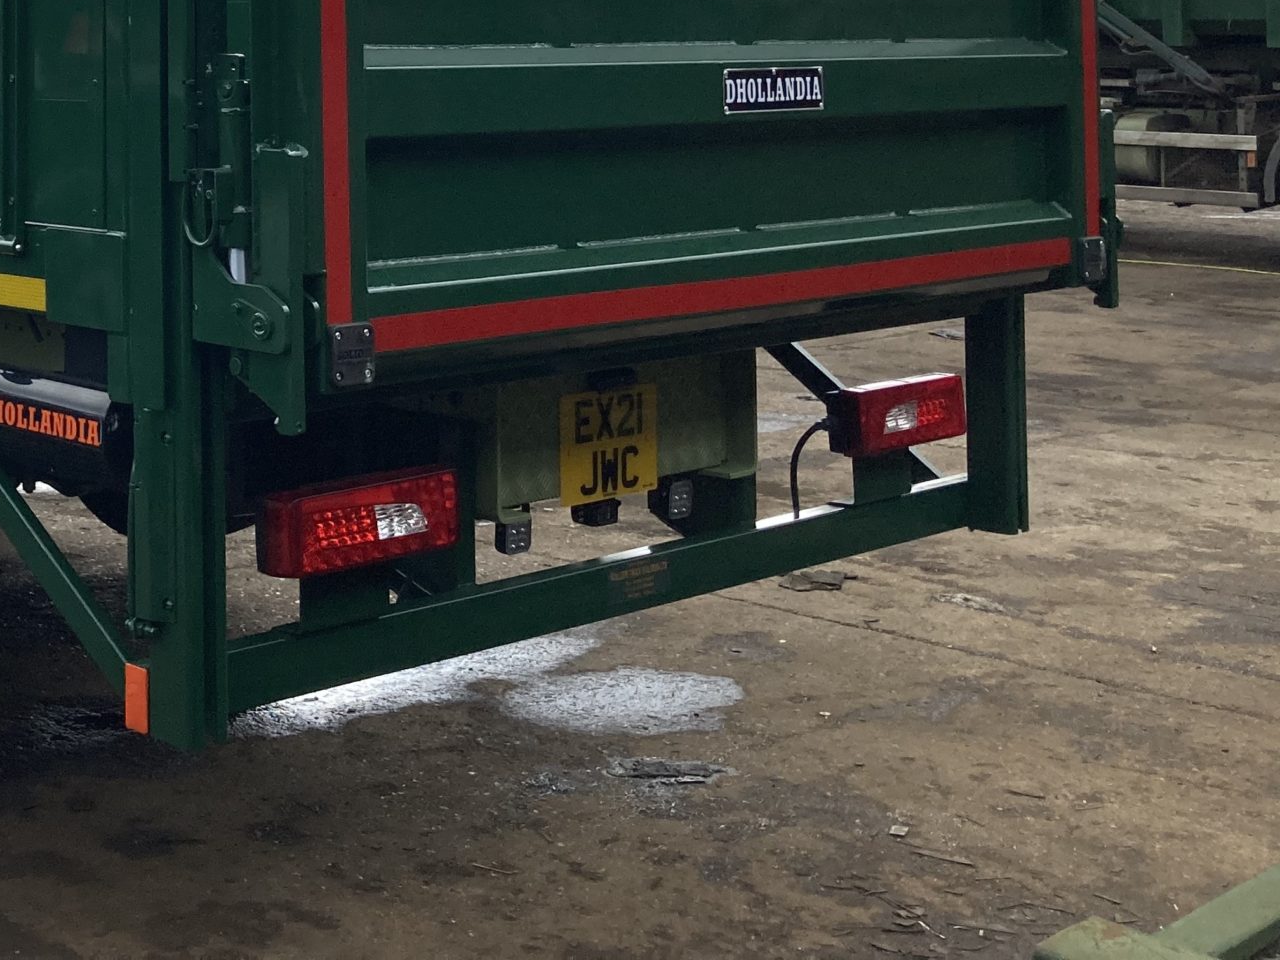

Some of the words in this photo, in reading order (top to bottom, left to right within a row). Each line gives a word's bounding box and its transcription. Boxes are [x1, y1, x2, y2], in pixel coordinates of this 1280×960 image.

[725, 76, 822, 104] DHOLLANDIA
[575, 392, 643, 444] EX21
[580, 445, 639, 496] JWC
